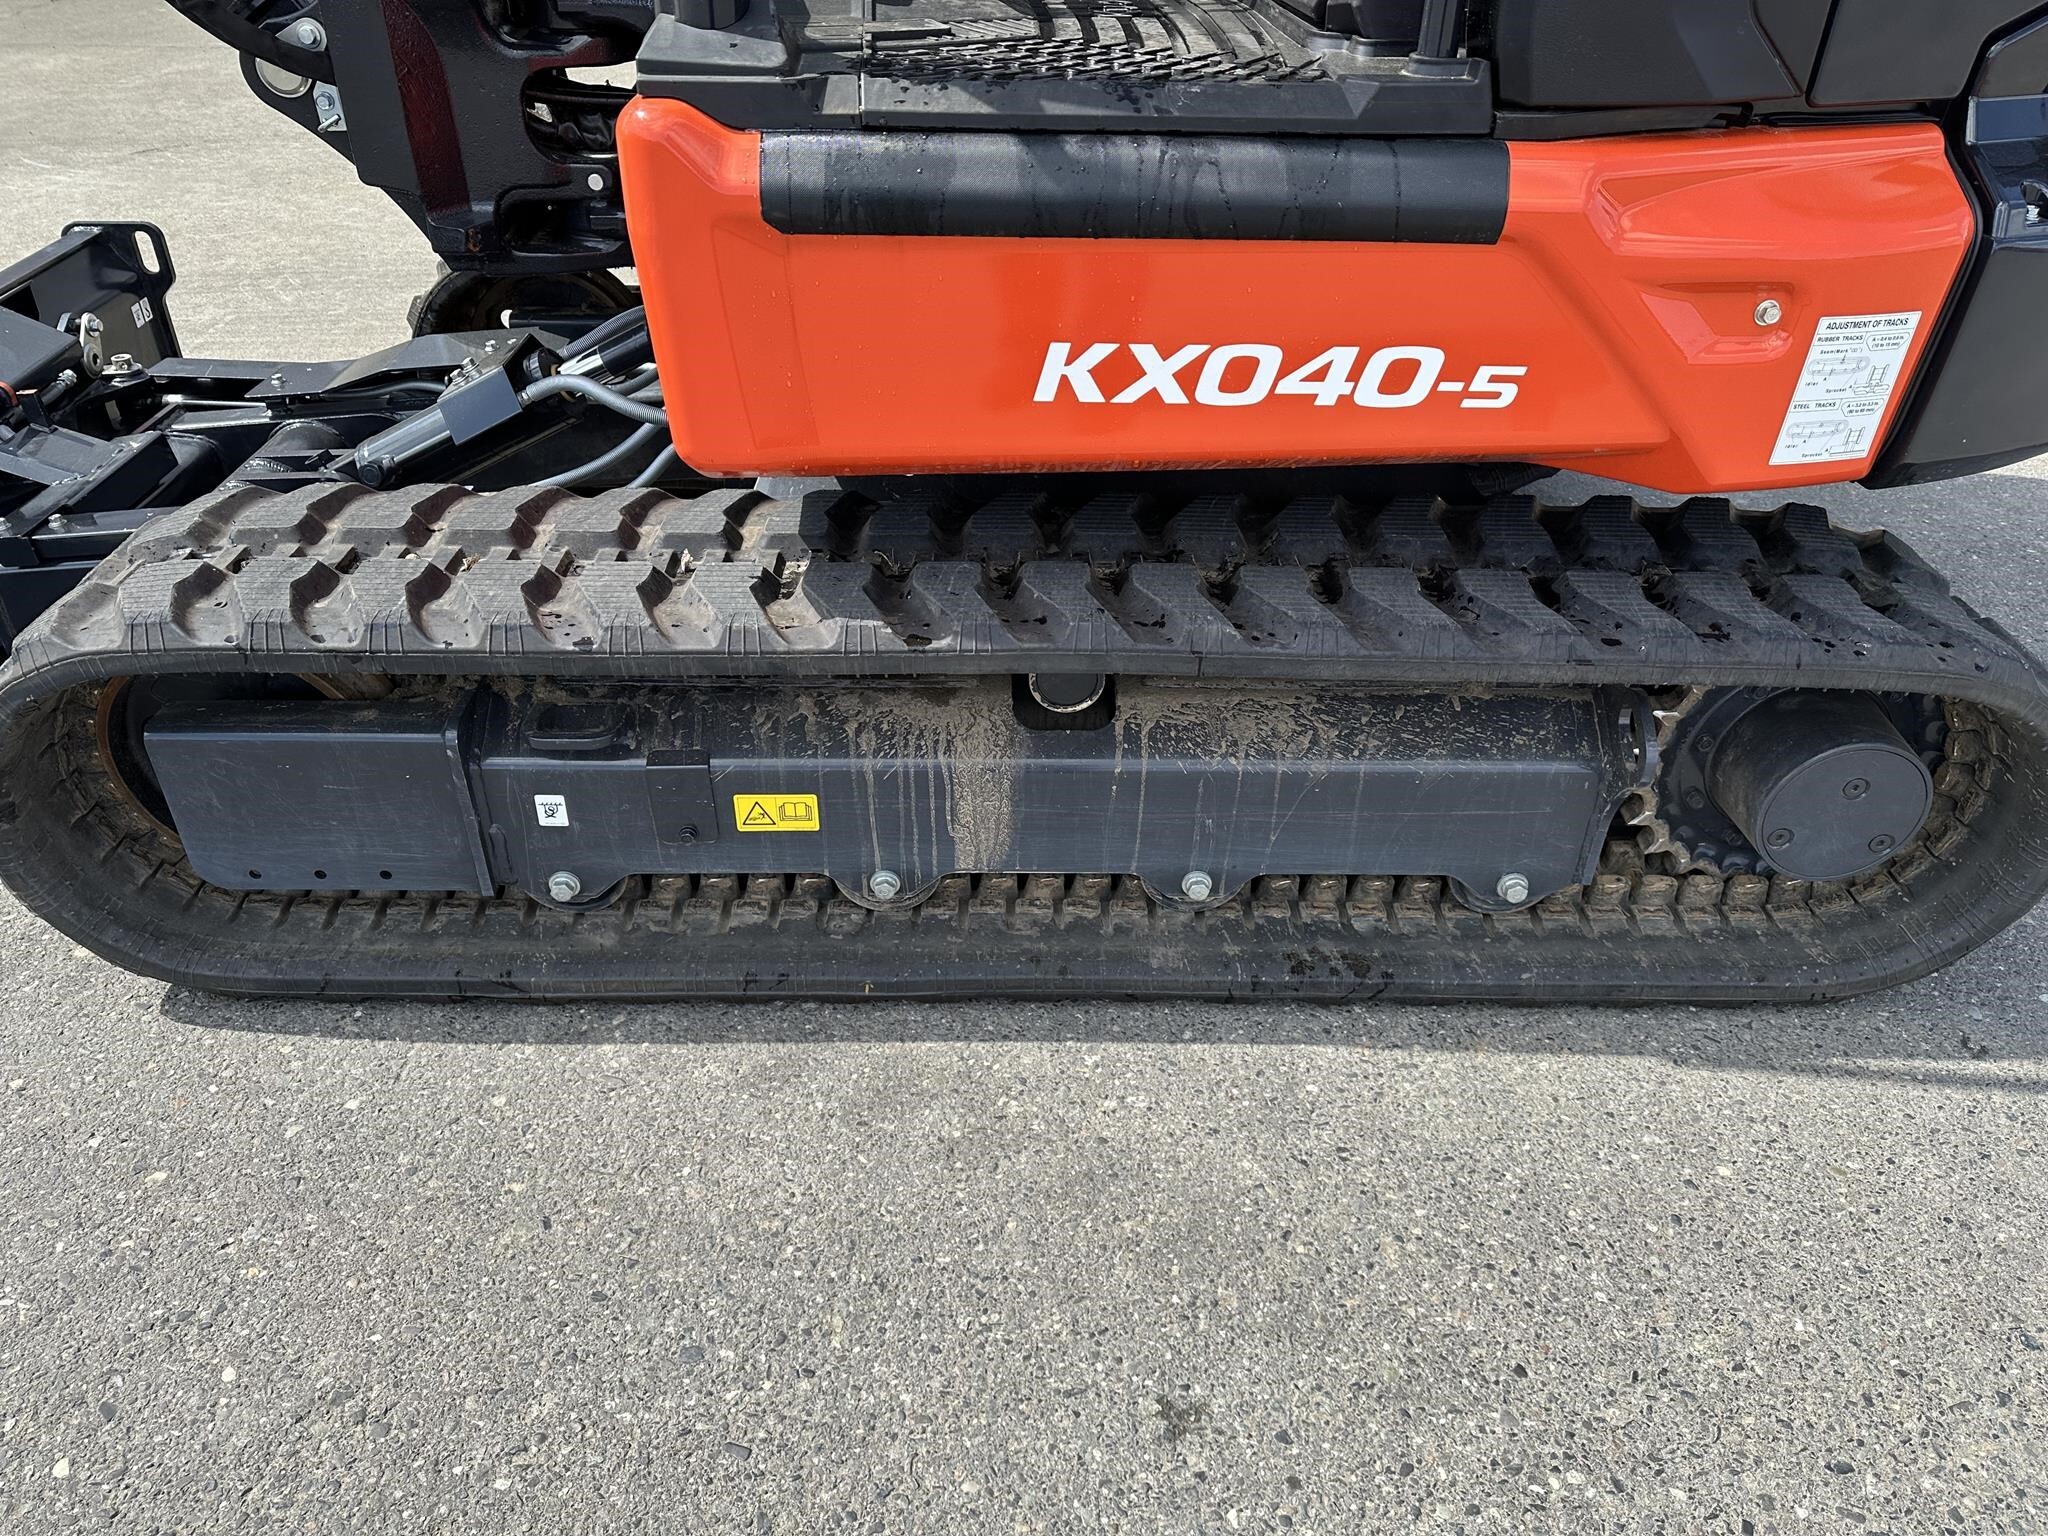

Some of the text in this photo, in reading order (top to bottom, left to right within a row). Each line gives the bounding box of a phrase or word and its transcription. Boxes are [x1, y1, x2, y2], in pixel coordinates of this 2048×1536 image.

[1826, 317, 1909, 330] ADJUSTMENT OF TRACKS
[1033, 341, 1527, 408] KX040-5
